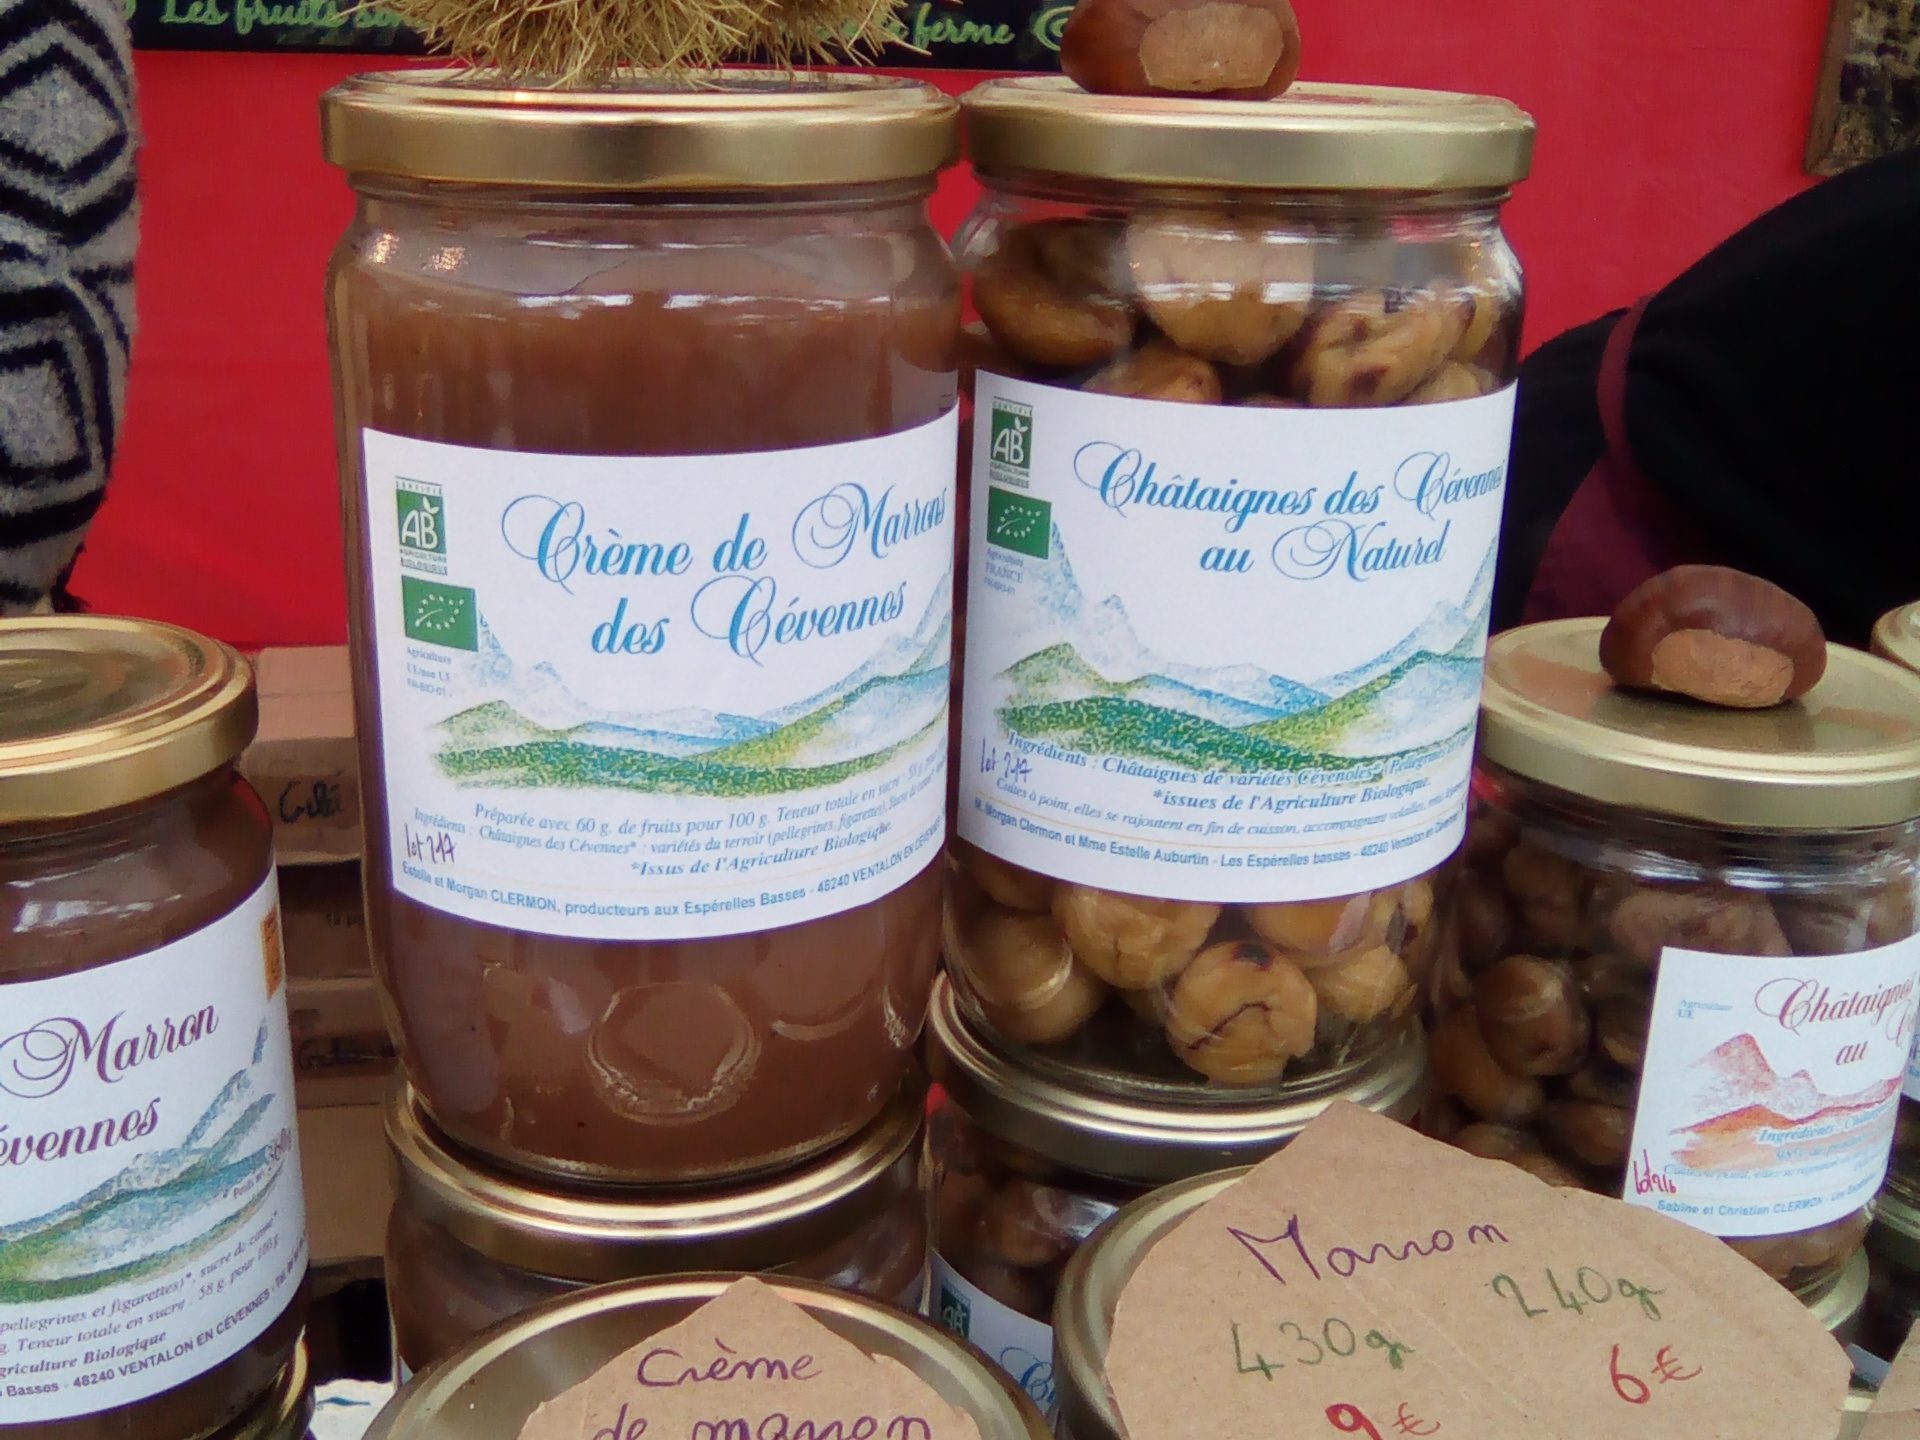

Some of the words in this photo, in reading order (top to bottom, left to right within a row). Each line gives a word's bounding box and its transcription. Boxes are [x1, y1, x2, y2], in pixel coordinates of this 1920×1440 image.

[914, 2, 1016, 50] ferme
[993, 427, 1025, 464] AB
[1073, 440, 1318, 533] Châtaignes
[1323, 470, 1385, 515] des
[401, 508, 438, 550] AB
[501, 494, 692, 595] Crème
[712, 512, 768, 573] de
[1199, 543, 1255, 573] au
[1272, 518, 1451, 583] Naturel
[590, 598, 670, 656] des
[690, 575, 908, 668] Cévennes
[1008, 730, 1087, 768] Ingrédients
[1103, 757, 1197, 784] Châtaignes
[1202, 770, 1223, 785] de
[1229, 770, 1293, 787] variétés
[474, 803, 535, 828] Préparée
[538, 817, 570, 832] avec
[576, 817, 596, 833] 60
[618, 818, 637, 834] de
[640, 818, 682, 840] fruits
[685, 817, 724, 836] pour
[728, 811, 755, 829] 100
[776, 800, 821, 823] Teneur
[1223, 795, 1244, 810] de
[1249, 793, 1359, 814] l'Agriculture
[404, 823, 424, 863] lot
[479, 825, 543, 849] Châtaignes
[545, 833, 566, 851] des
[704, 834, 722, 850] du
[724, 831, 765, 850] terroir
[1019, 817, 1063, 843] Clermon
[1064, 835, 1076, 847] et
[1109, 841, 1151, 860] Estelle
[1153, 847, 1209, 866] Auburtin
[1220, 853, 1243, 868] Les
[1227, 820, 1246, 835] de
[690, 858, 711, 874] de
[715, 844, 820, 872] l'Agriculture
[434, 874, 444, 889] et
[447, 877, 488, 901] Morgan
[565, 902, 650, 917] producteurs
[654, 903, 679, 916] aux
[760, 887, 806, 907] Basses
[0, 1004, 220, 1099] Marron
[1835, 1041, 1869, 1066] au
[1657, 1199, 1700, 1214] Sabine
[1703, 1205, 1714, 1215] et
[91, 1305, 107, 1318] et
[1492, 1266, 1664, 1322] 240g
[17, 1334, 73, 1352] Teneur
[78, 1322, 122, 1343] totale
[126, 1317, 144, 1331] en
[83, 1331, 168, 1366] Biologique
[1229, 1317, 1415, 1382] 430g
[5, 1381, 61, 1398] Basses
[73, 1368, 116, 1388] 48240
[117, 1338, 195, 1378] VENTALON
[196, 1328, 214, 1347] EN
[636, 1337, 824, 1387] Crème
[592, 1402, 649, 1440] de
